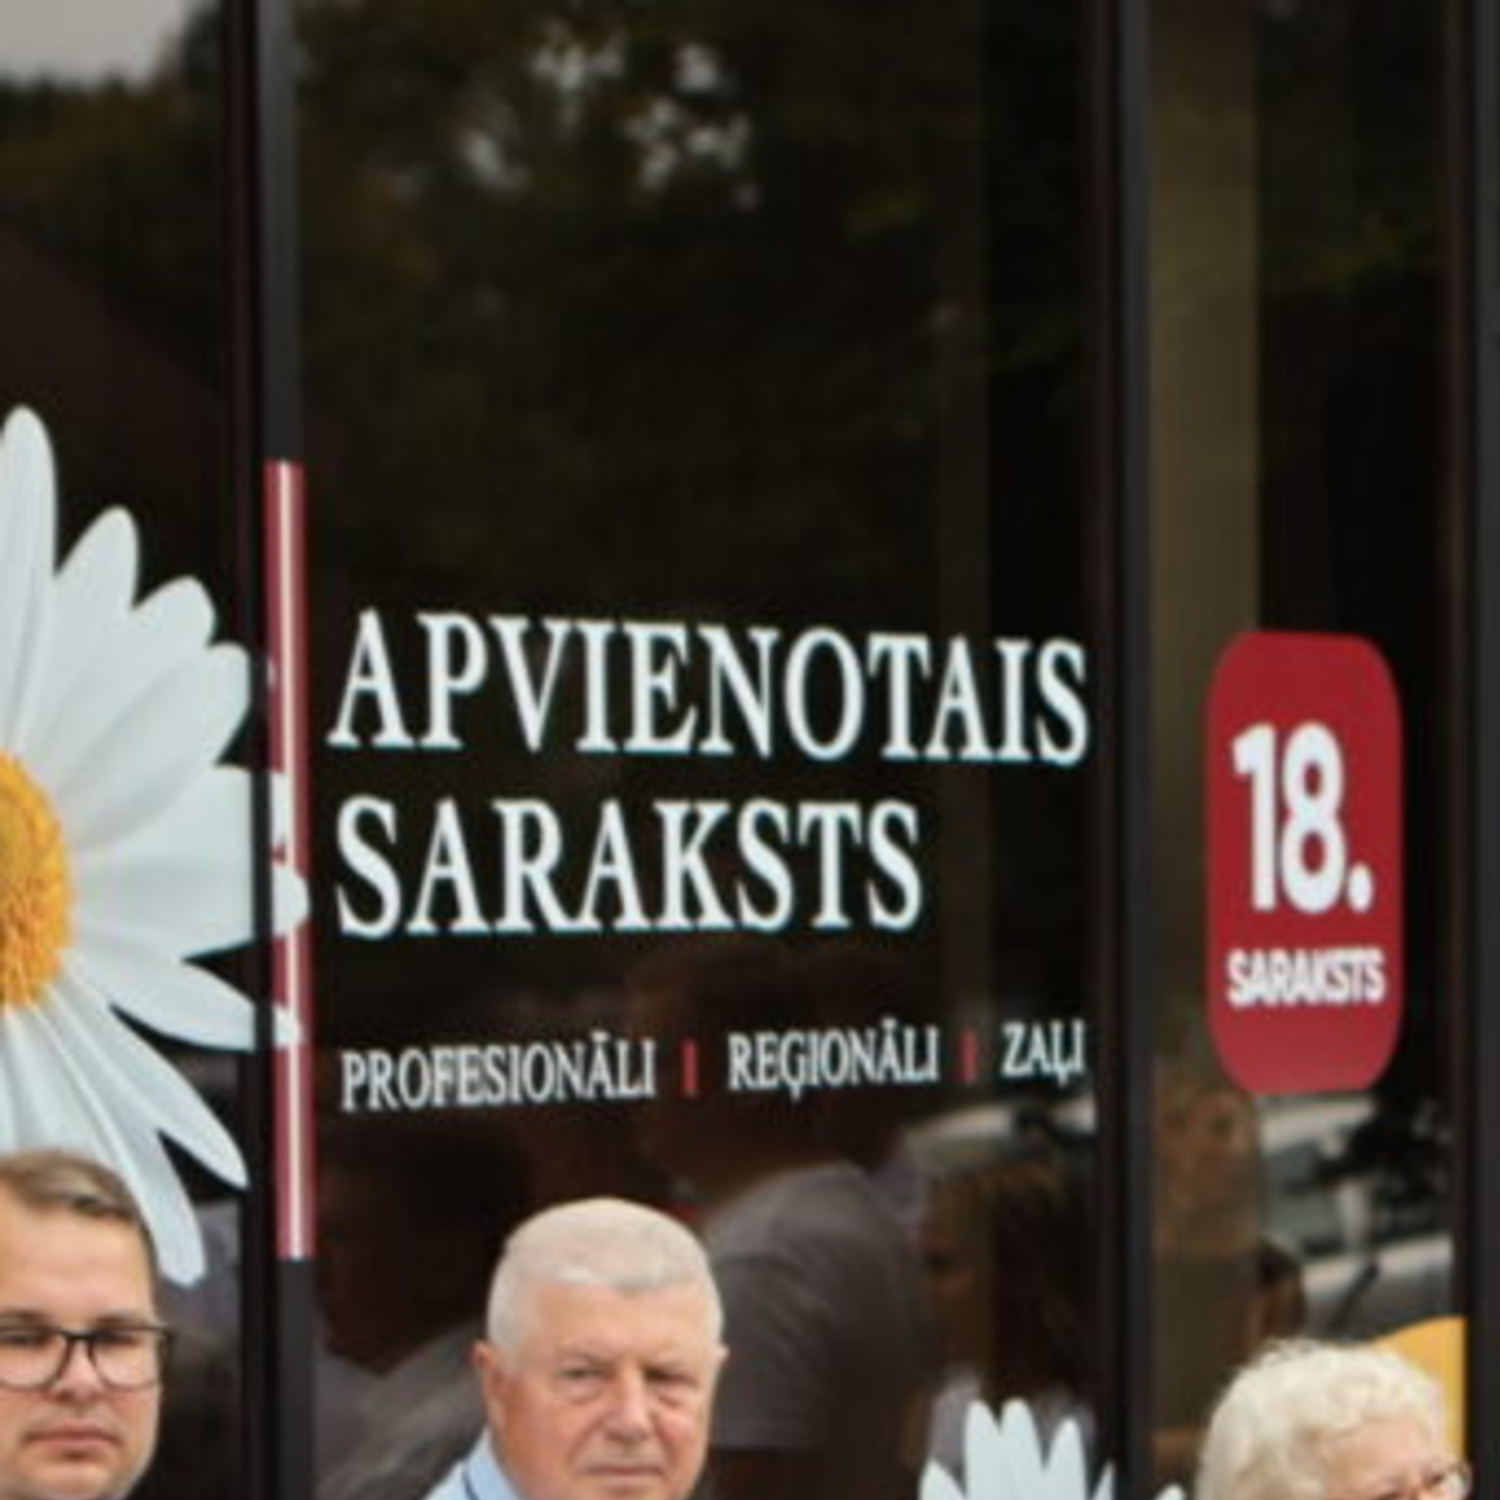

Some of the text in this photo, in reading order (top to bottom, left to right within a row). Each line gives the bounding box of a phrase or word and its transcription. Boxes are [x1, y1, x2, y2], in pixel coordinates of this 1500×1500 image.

[327, 608, 1089, 767] APVIENOTAIS
[335, 794, 922, 939] SARAKSTS
[1231, 721, 1374, 914] 18.
[1226, 947, 1386, 1007] SARAKSTS
[338, 1030, 658, 1112] PROFESIONĀLI
